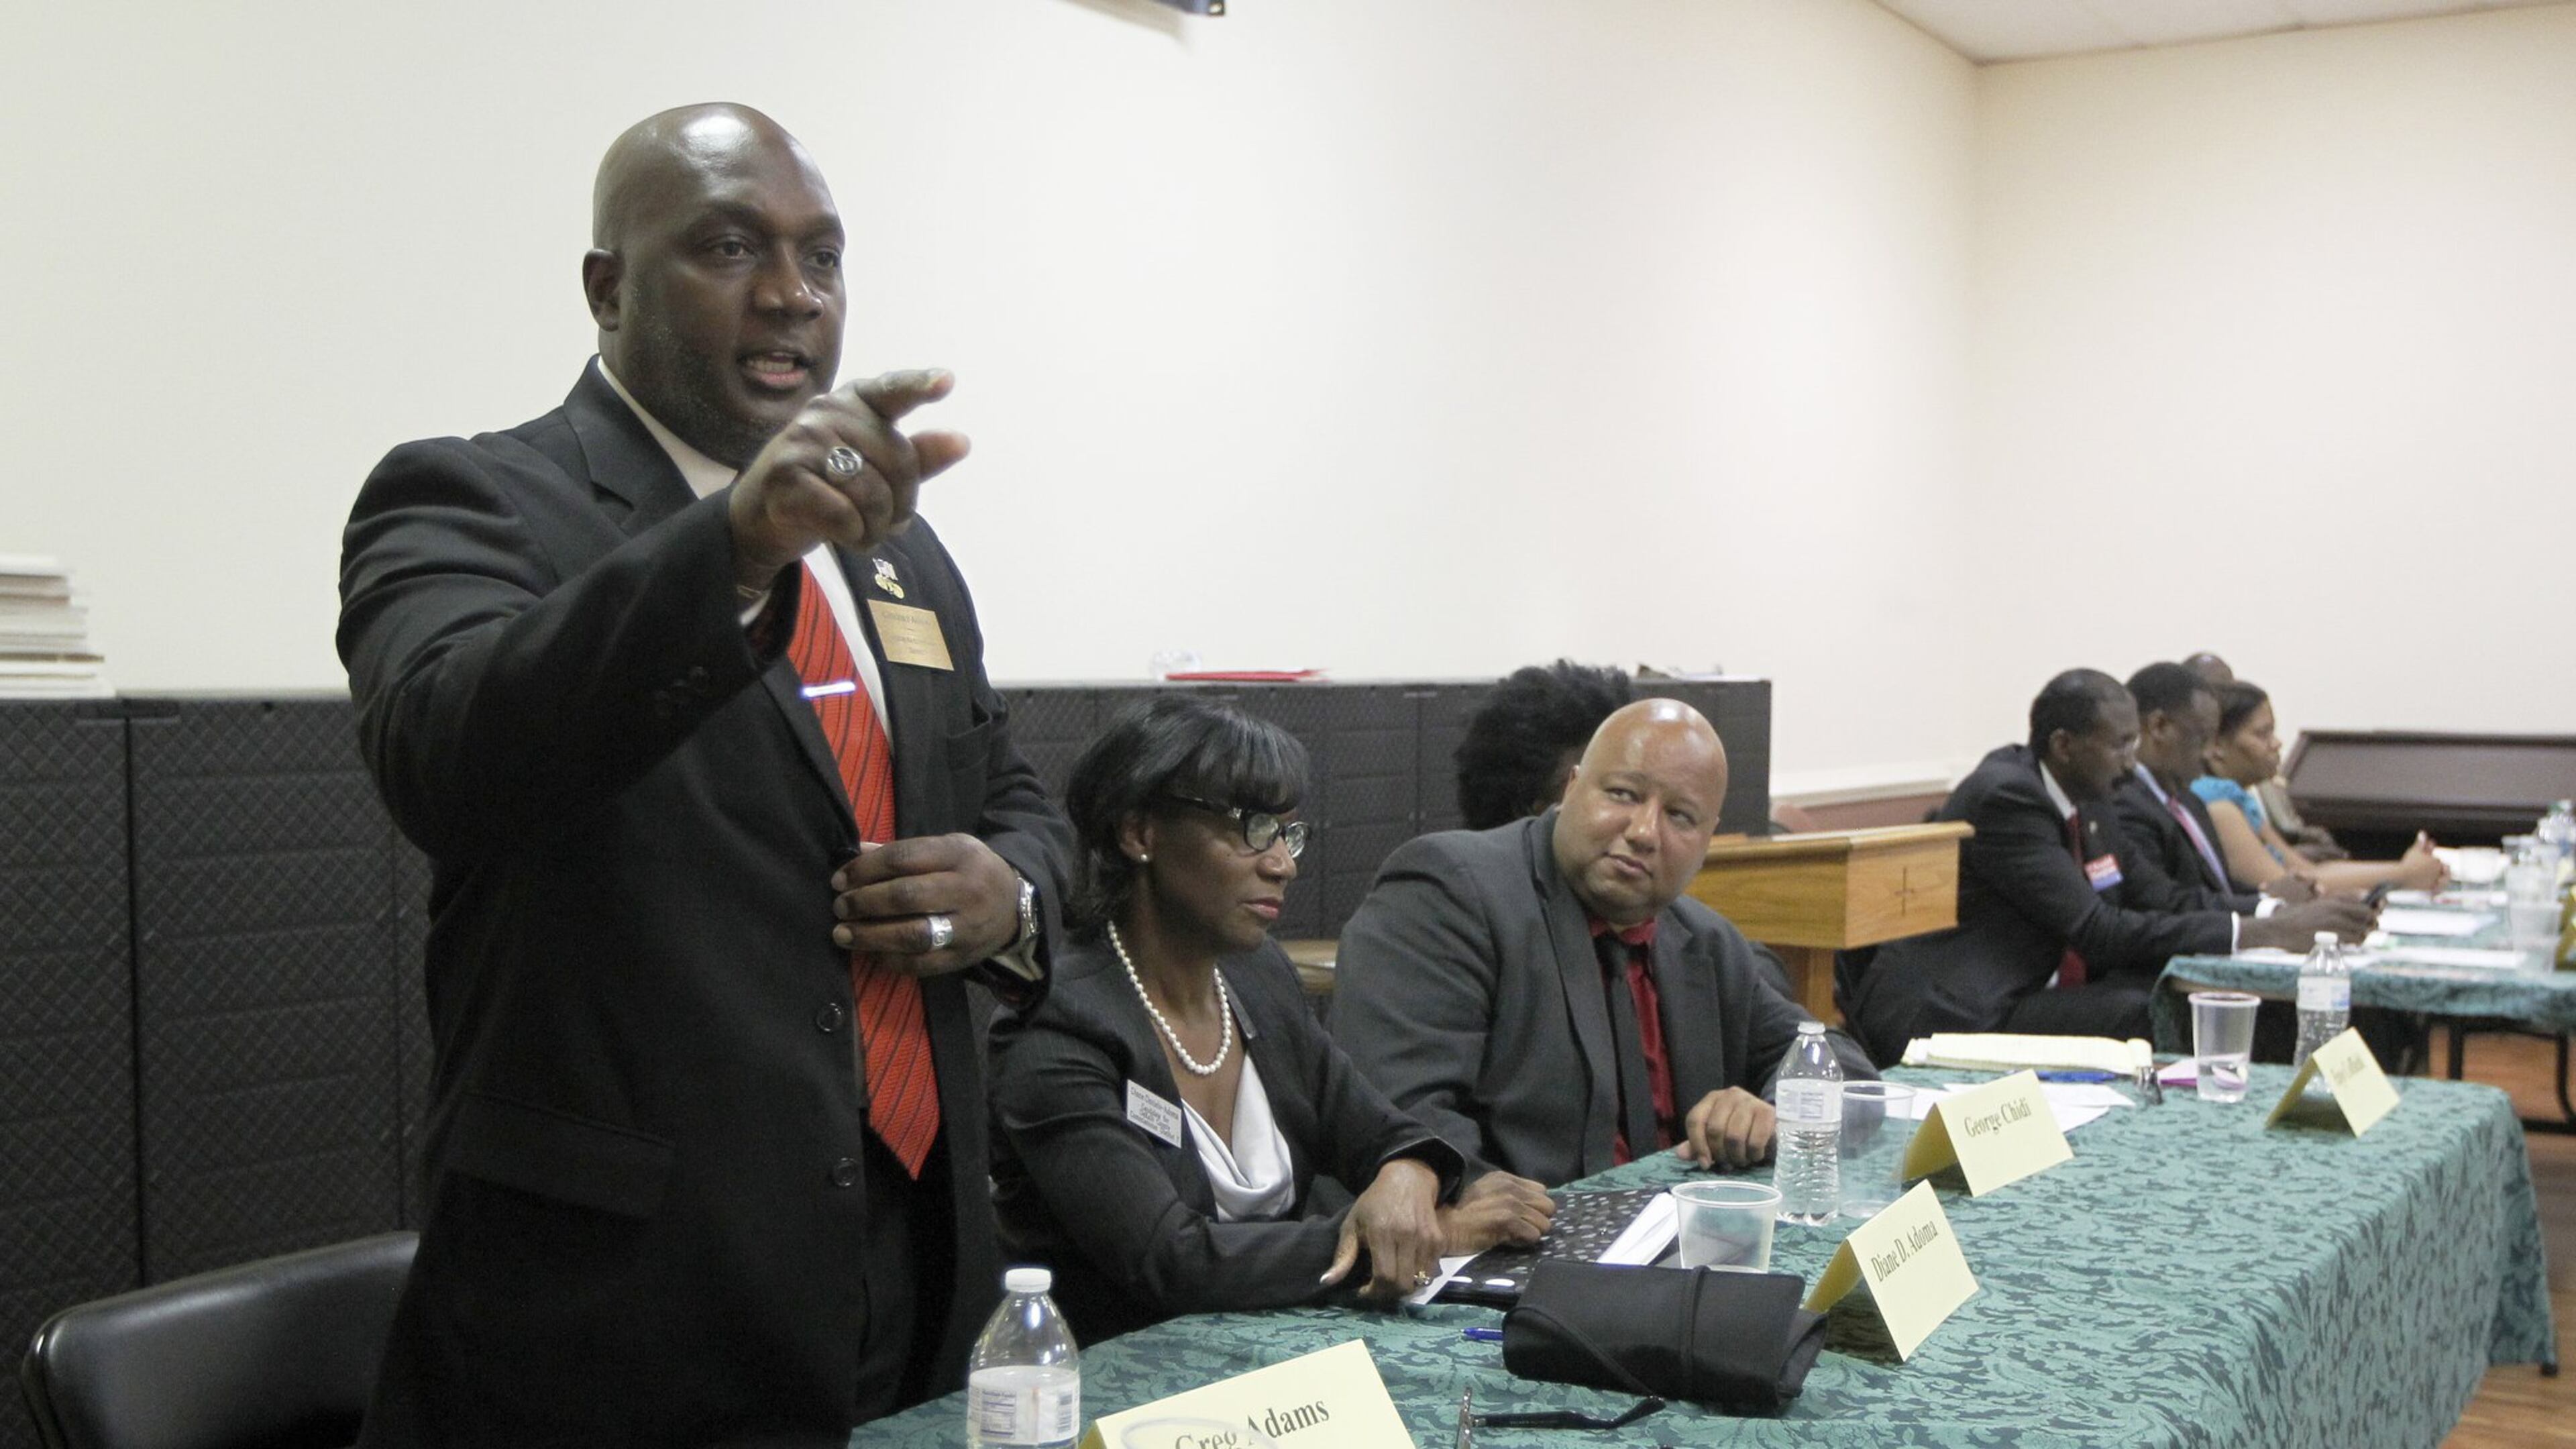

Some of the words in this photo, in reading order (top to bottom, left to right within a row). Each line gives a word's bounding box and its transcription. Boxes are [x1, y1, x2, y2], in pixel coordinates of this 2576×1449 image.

[1964, 1112, 2002, 1138] George
[2000, 1097, 2031, 1124] Chidi
[1871, 1250, 1900, 1282] Diane
[1894, 1238, 1911, 1263] D.
[1907, 1220, 1938, 1254] Adoma
[1247, 1400, 1330, 1446] Adams
